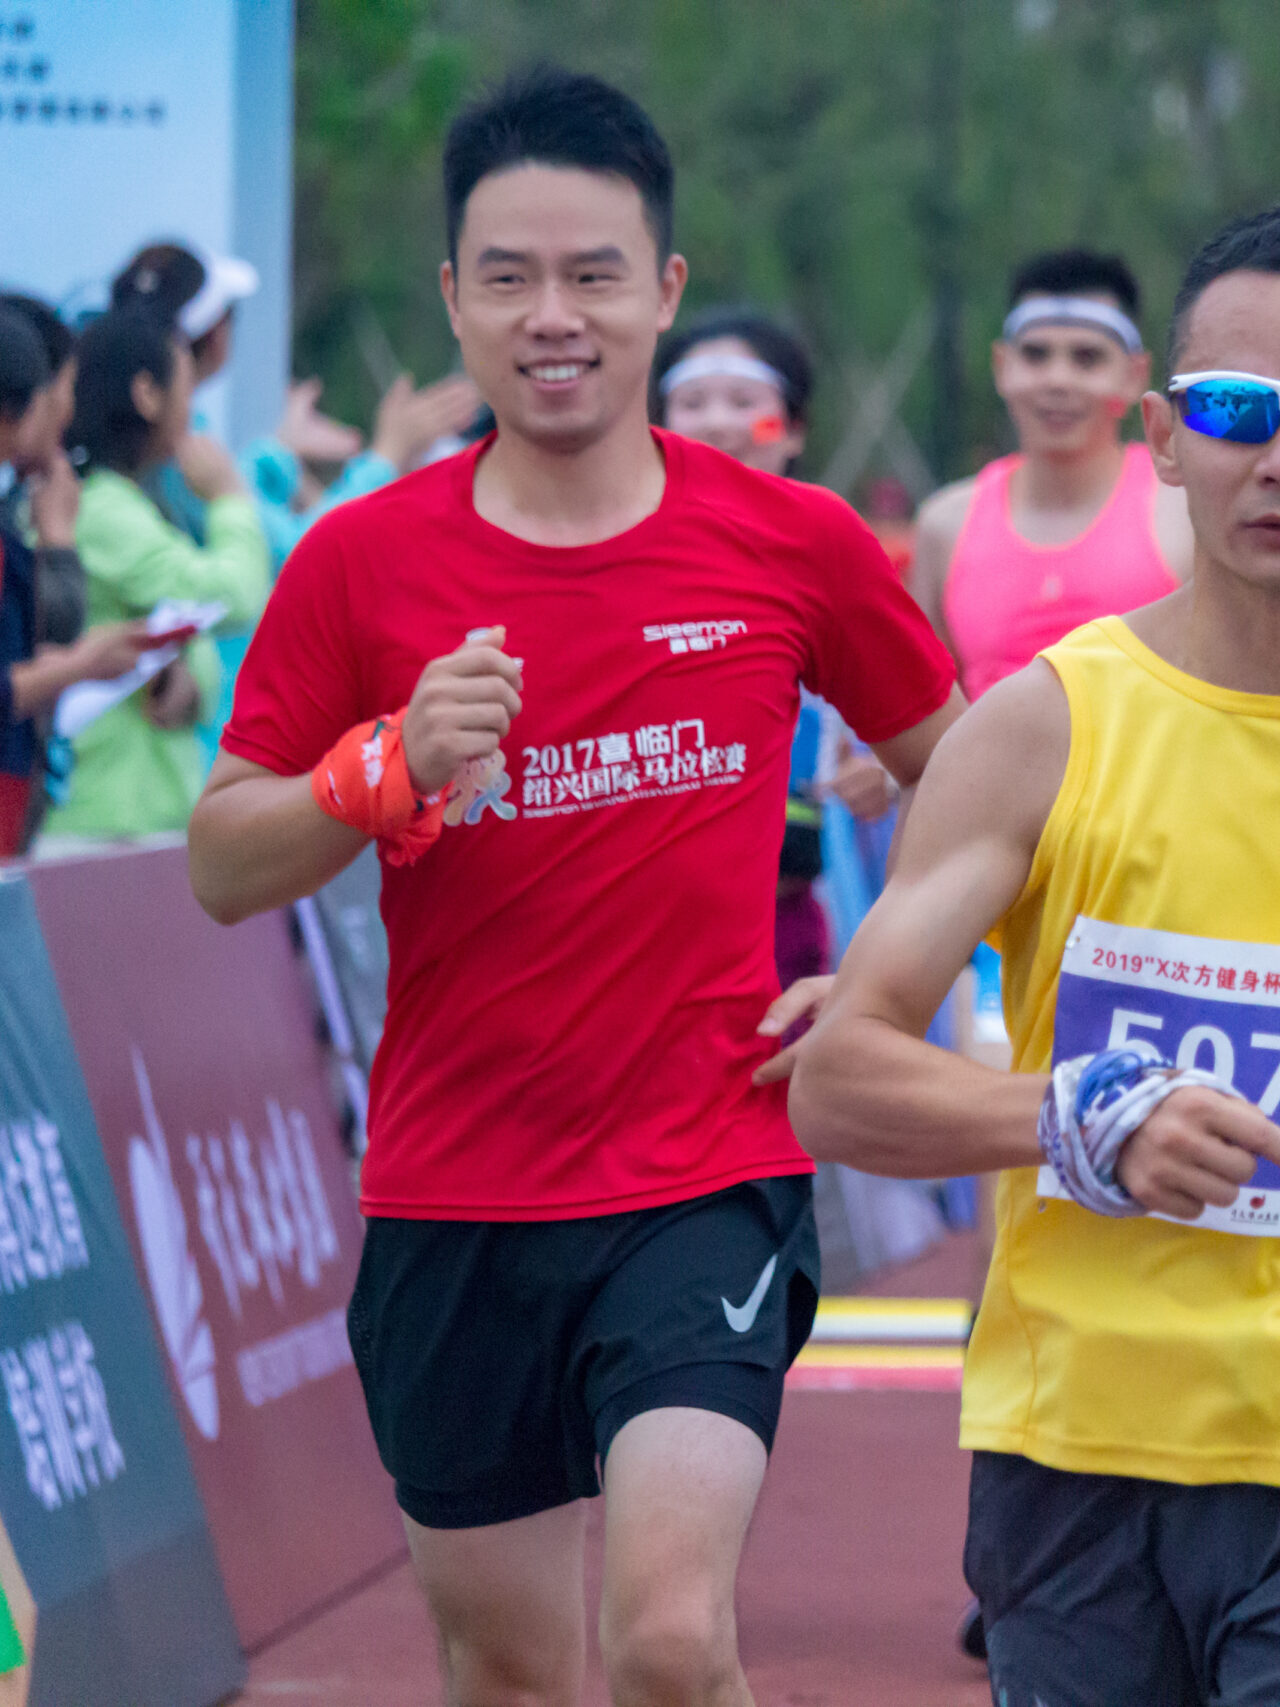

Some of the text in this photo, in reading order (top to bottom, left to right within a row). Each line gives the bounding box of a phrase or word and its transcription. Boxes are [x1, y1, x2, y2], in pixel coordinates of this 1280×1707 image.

[522, 718, 706, 777] 2017喜临门
[522, 742, 746, 806] 绍兴国际马拉松赛
